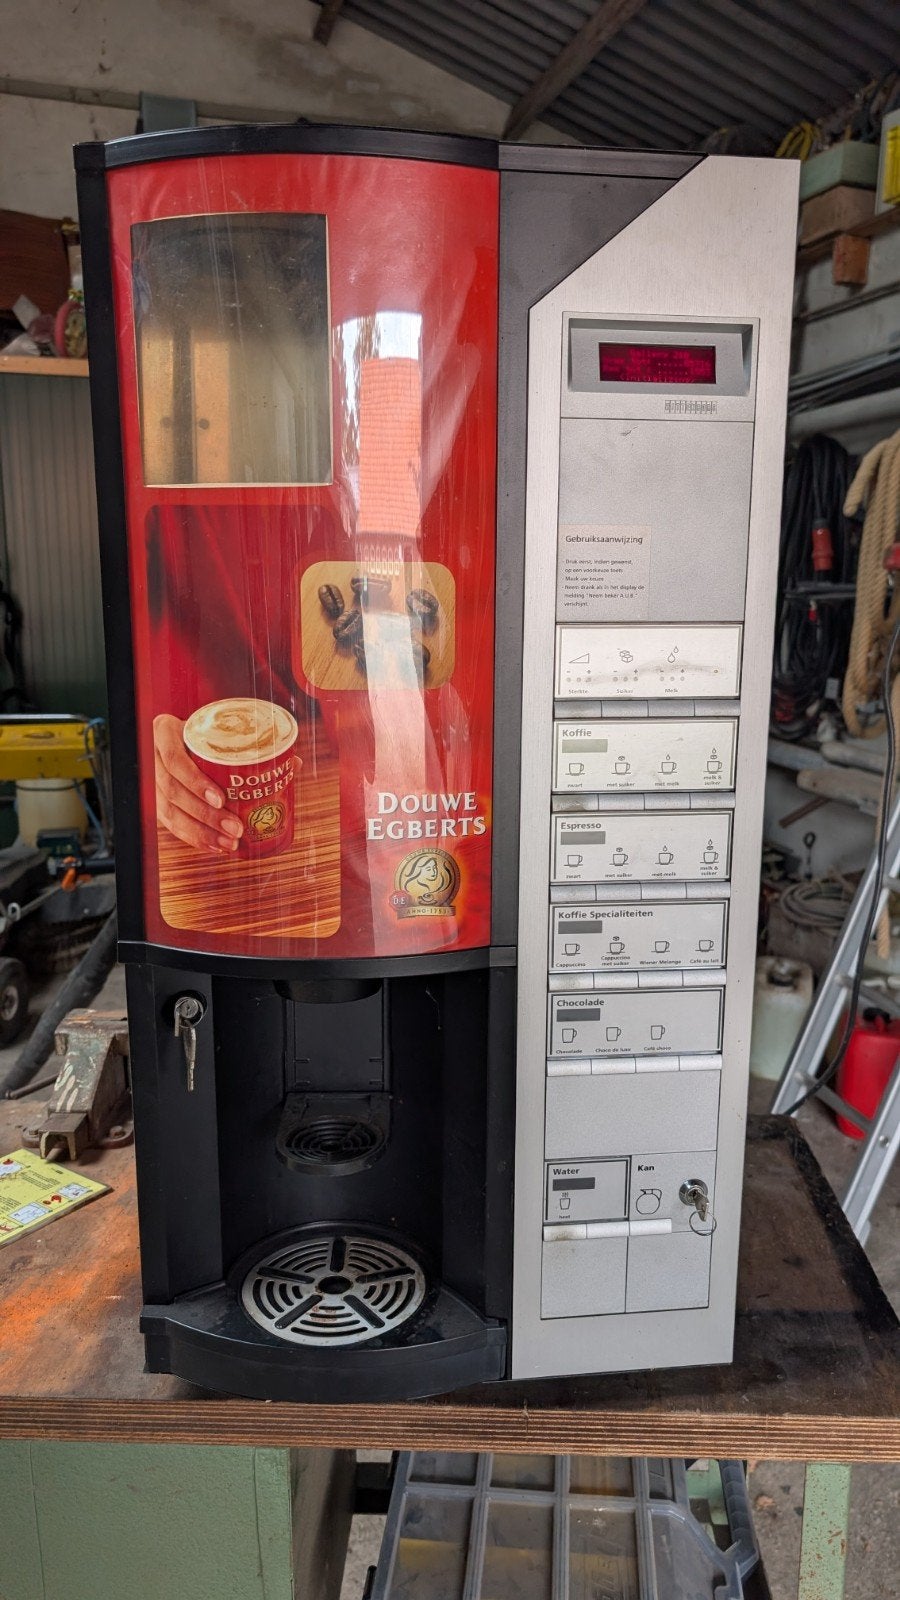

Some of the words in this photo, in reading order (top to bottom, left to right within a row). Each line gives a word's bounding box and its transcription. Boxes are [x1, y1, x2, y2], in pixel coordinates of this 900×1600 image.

[566, 536, 643, 545] Gebruiksaanwijzing
[562, 729, 592, 737] Koffie
[230, 756, 292, 788] DOUWE
[226, 771, 294, 800] EGBERTS
[377, 792, 478, 814] DOUWE
[366, 816, 487, 840] EGBERTS
[561, 822, 602, 831] Espresso
[558, 911, 587, 919] Koffie
[590, 910, 653, 919] Specialiteiten
[553, 1168, 580, 1176] Water
